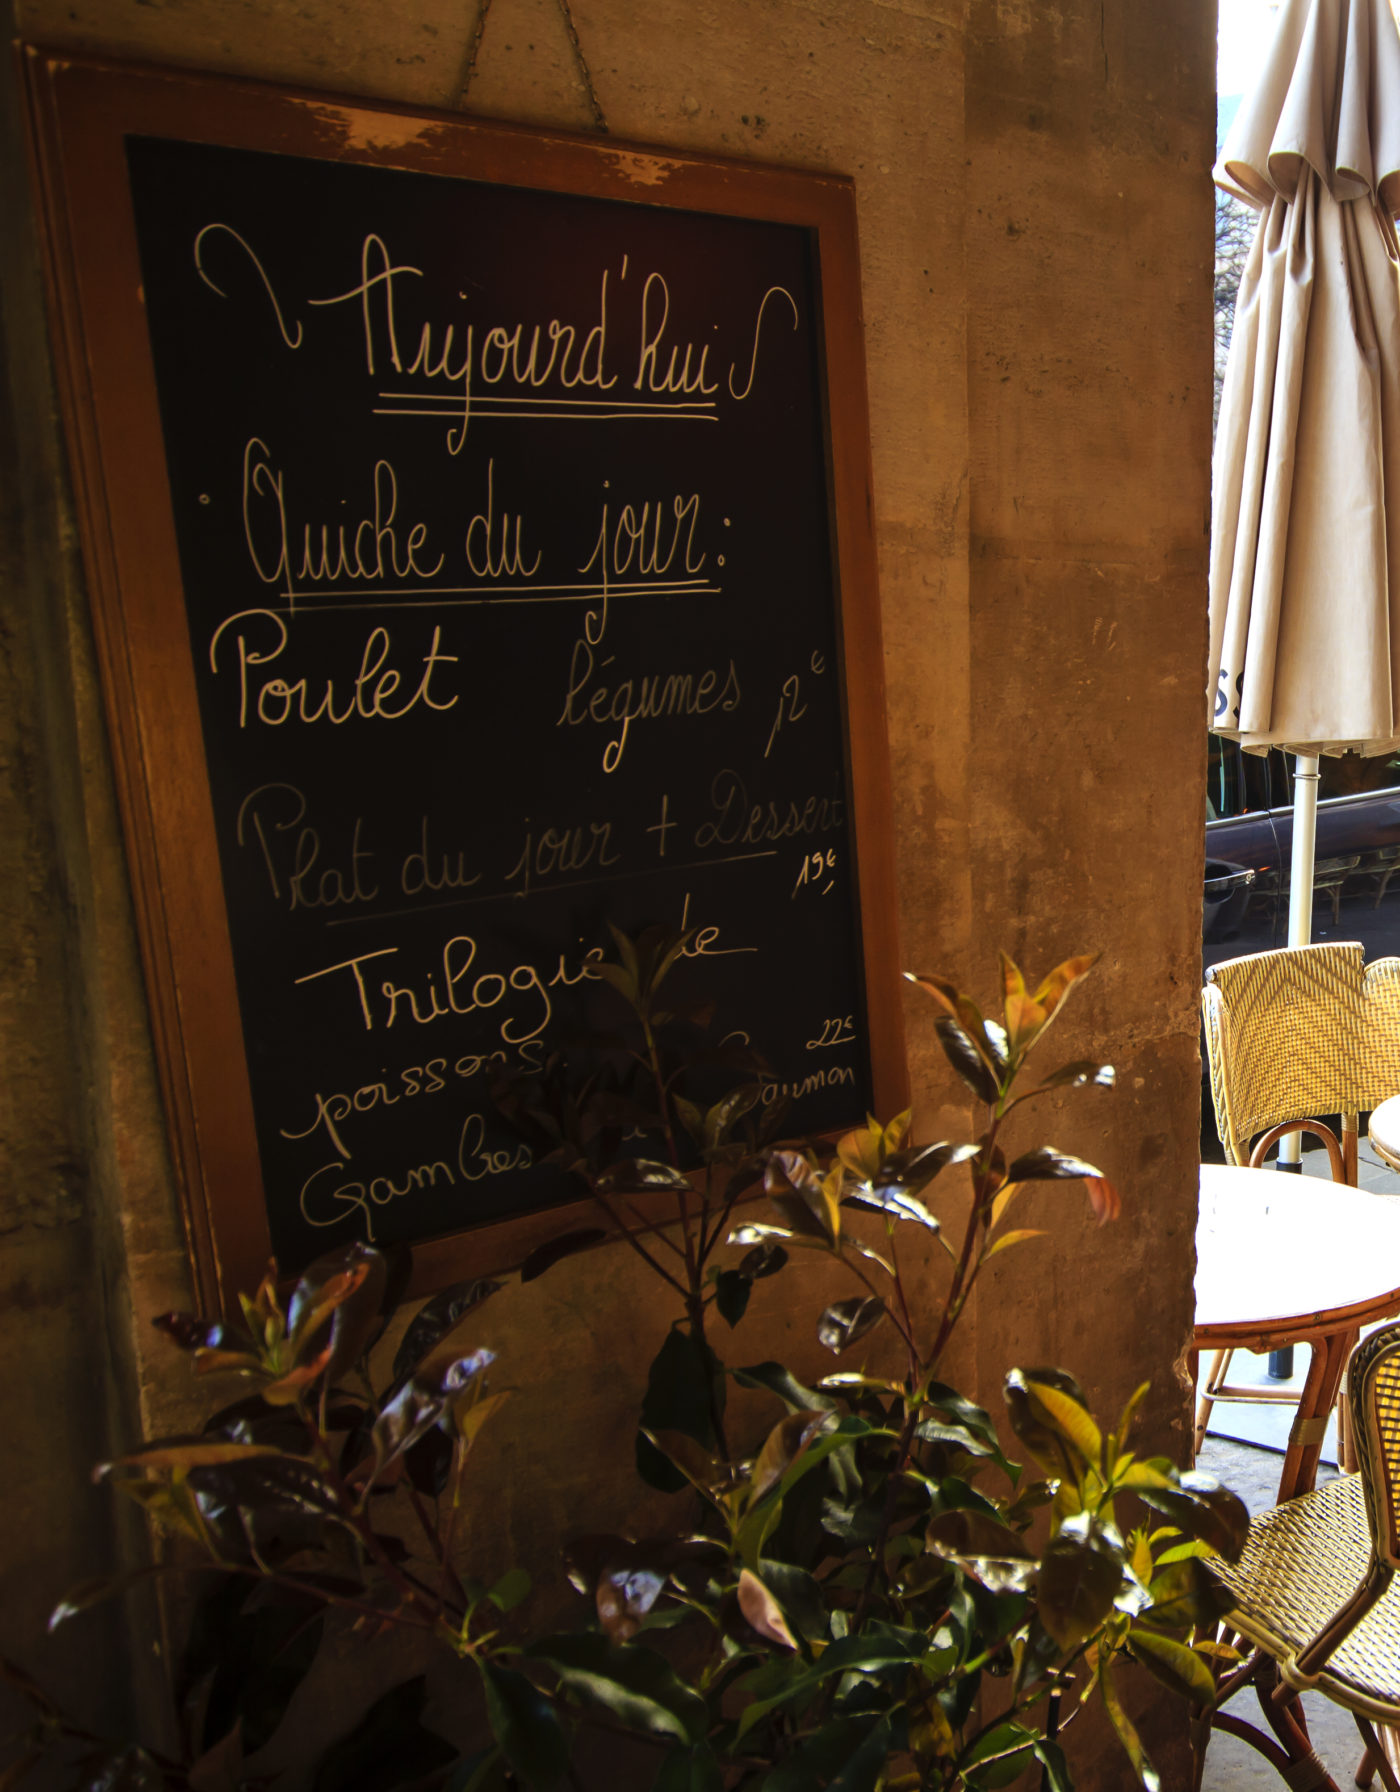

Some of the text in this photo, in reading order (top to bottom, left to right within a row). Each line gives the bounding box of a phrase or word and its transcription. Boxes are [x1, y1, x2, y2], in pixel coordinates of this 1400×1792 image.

[243, 437, 444, 619] Quiche
[465, 457, 542, 577] du
[210, 607, 460, 728] Poulet
[555, 637, 742, 774] légumes
[236, 782, 380, 912] Plat
[400, 815, 483, 896] du
[504, 817, 622, 900] jour
[694, 768, 845, 848] Dessert
[294, 934, 605, 1044] Trilogie
